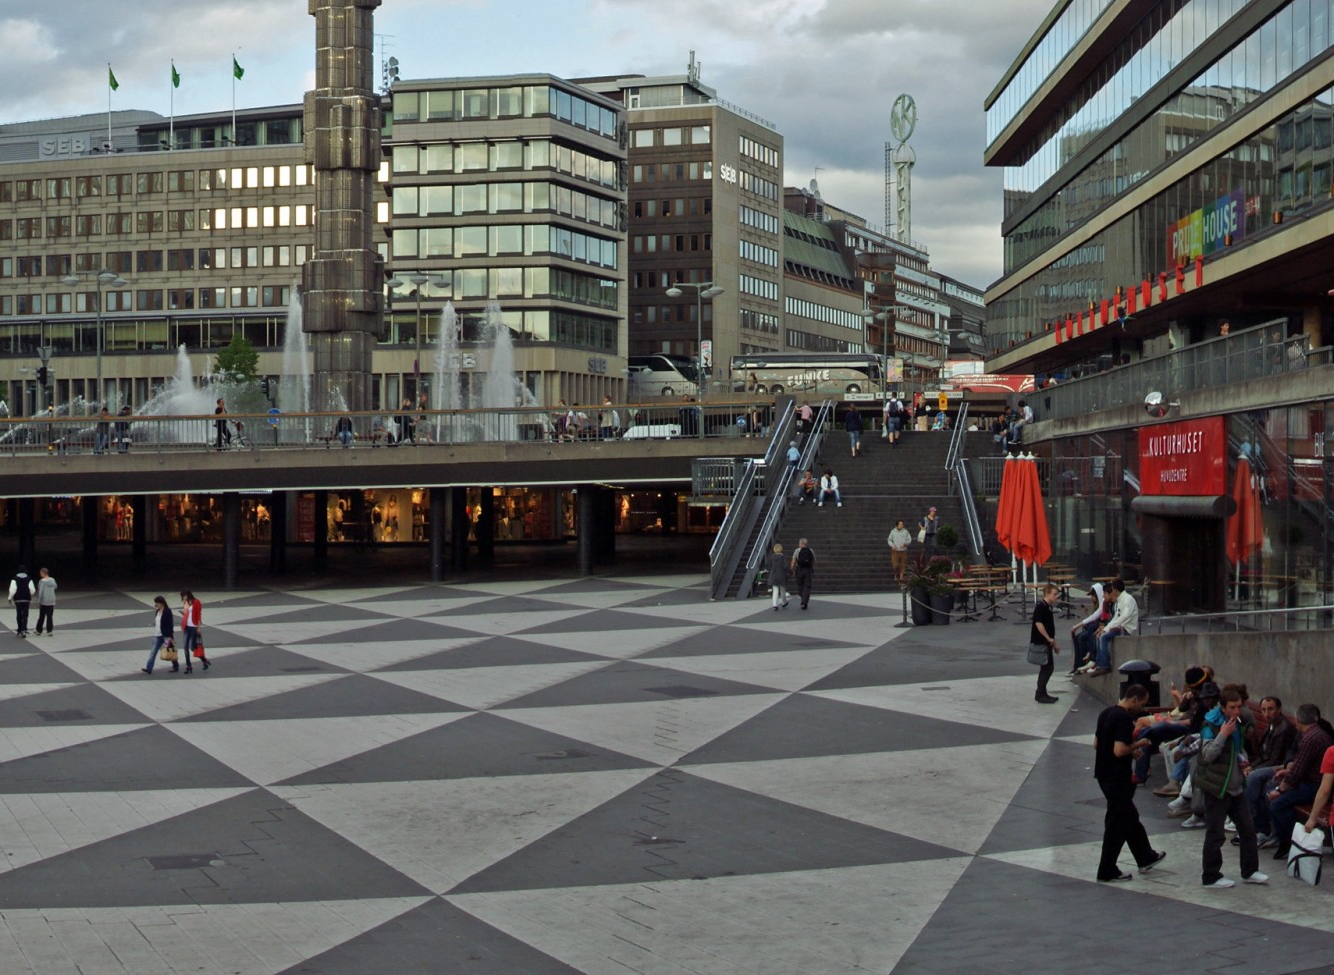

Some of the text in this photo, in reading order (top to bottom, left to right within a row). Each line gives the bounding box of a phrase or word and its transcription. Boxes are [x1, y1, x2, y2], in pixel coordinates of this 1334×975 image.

[42, 138, 86, 155] SEB
[720, 163, 737, 184] SEB
[1173, 219, 1200, 259] PRIDE
[1203, 200, 1238, 244] HOUSE
[588, 358, 607, 373] SEB
[787, 369, 830, 386] FUNKE
[1149, 431, 1203, 457] KULTURHUSET
